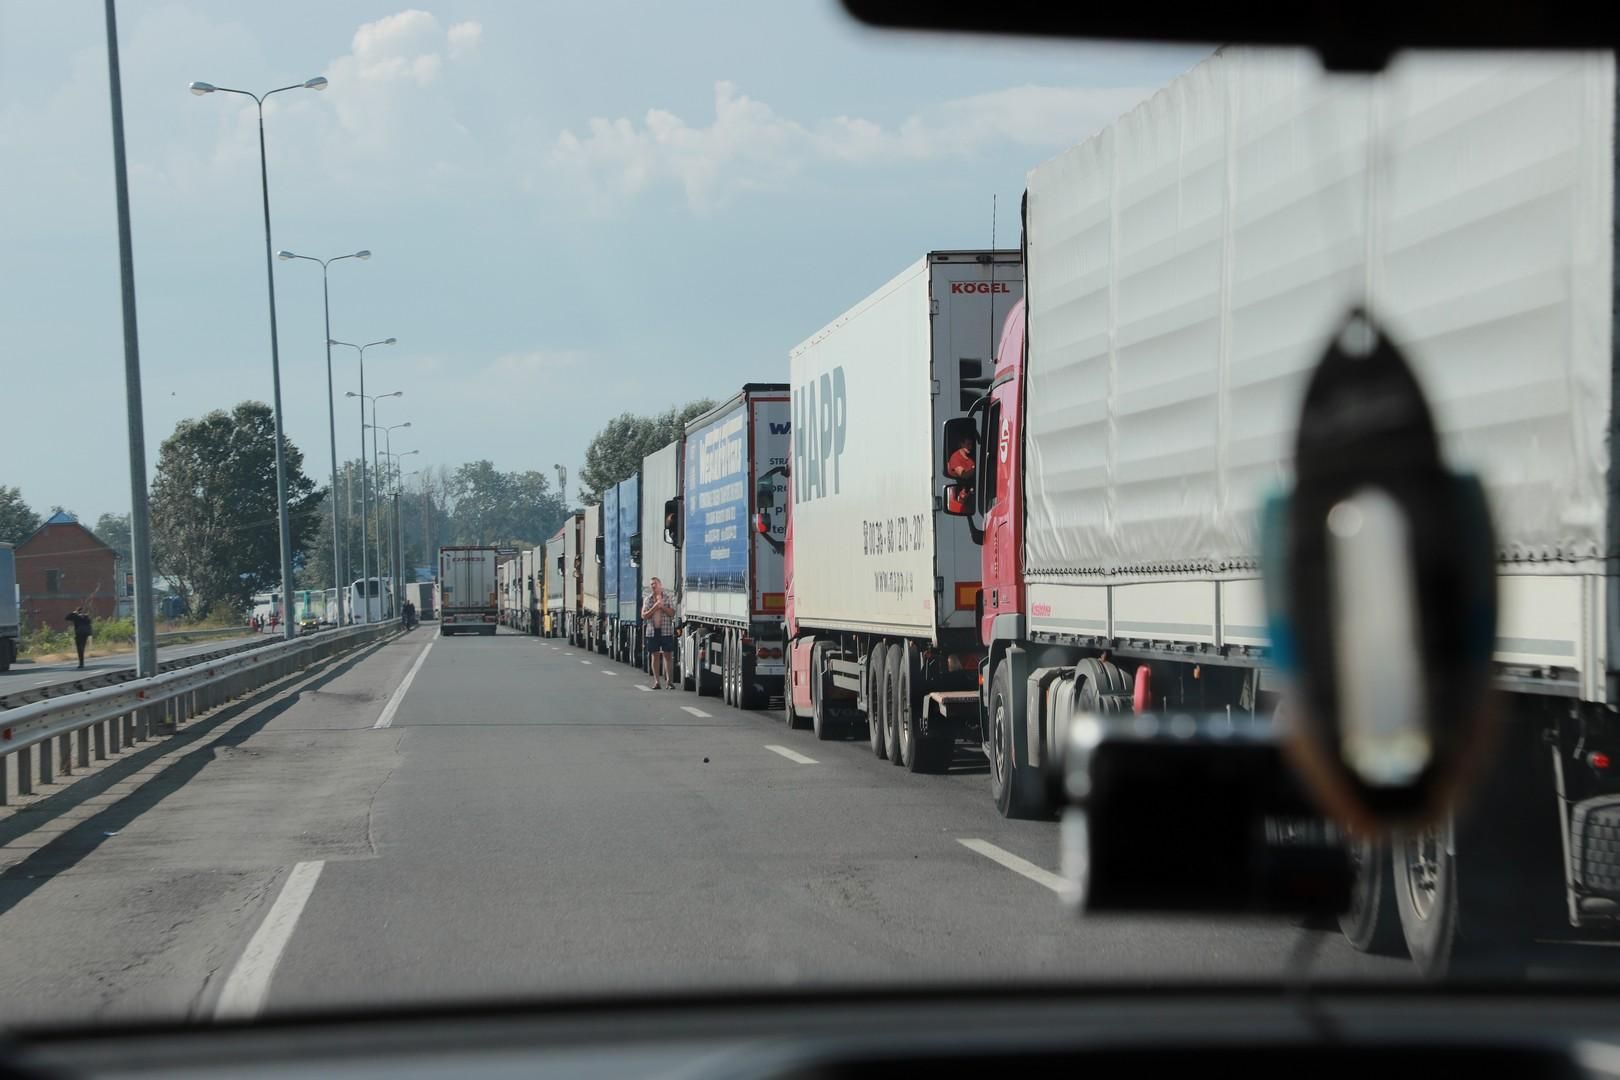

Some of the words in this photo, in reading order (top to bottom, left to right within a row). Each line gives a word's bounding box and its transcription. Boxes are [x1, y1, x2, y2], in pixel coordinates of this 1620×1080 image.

[951, 281, 1010, 294] KÖGEL
[769, 421, 792, 435] W
[793, 365, 847, 505] HAPP
